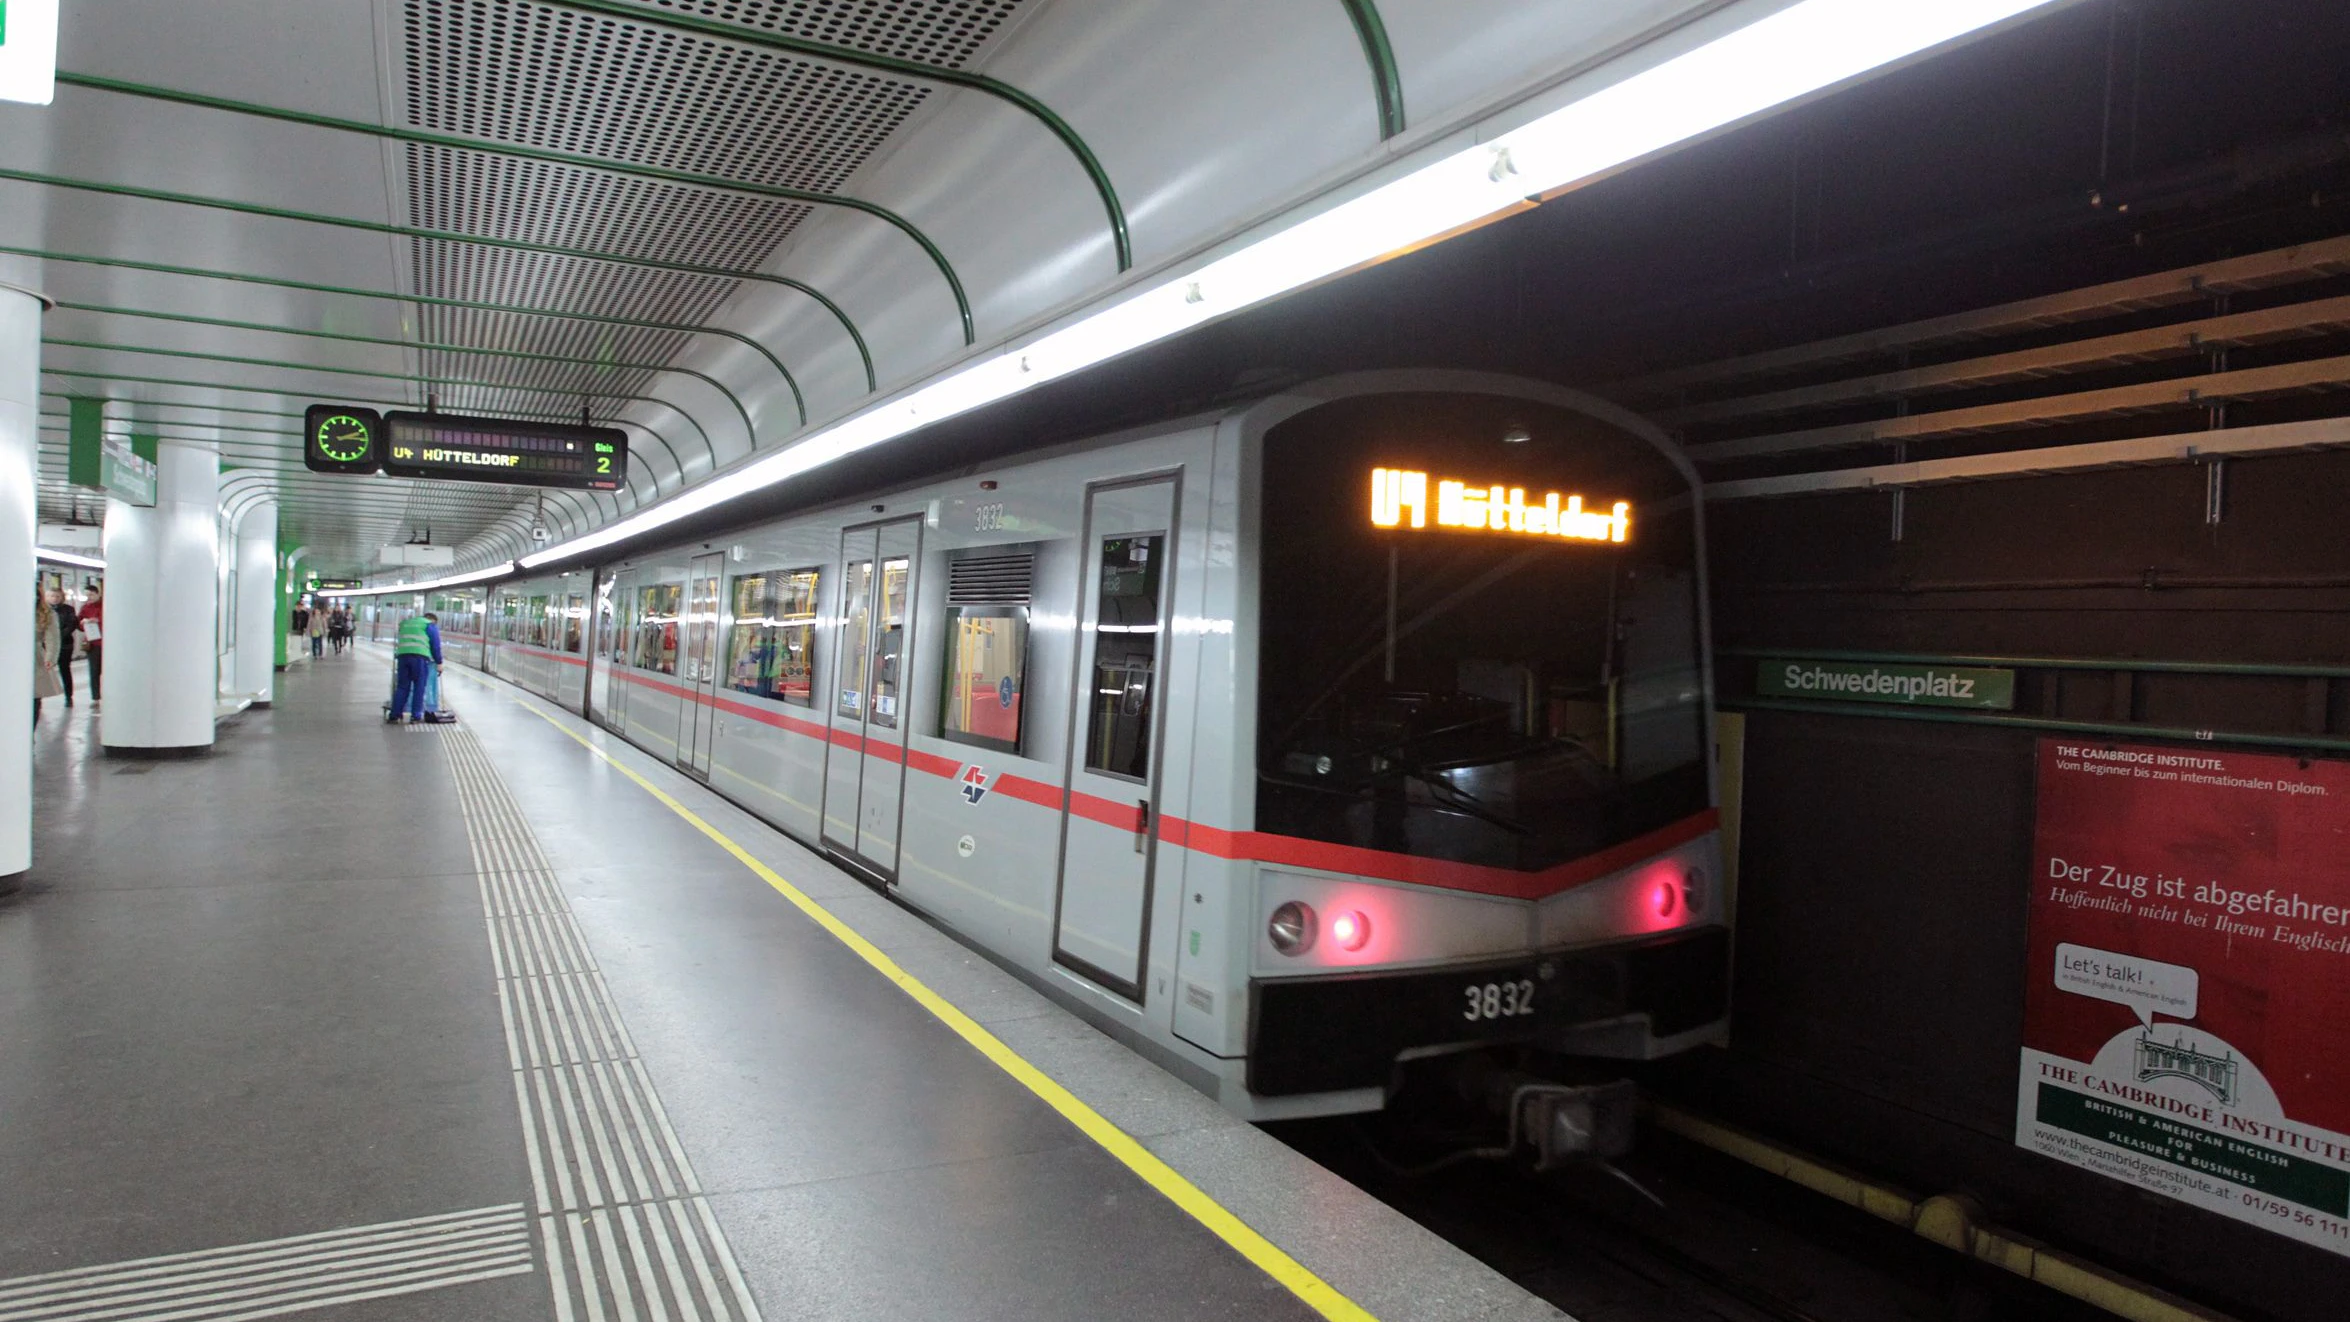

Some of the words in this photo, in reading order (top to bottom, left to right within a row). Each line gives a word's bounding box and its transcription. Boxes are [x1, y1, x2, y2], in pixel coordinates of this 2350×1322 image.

[394, 447, 413, 460] U4
[424, 449, 519, 466] HÜTTELDORF
[597, 457, 610, 473] 2
[1371, 468, 1427, 528] U4
[975, 504, 1003, 532] 3832
[1784, 664, 1976, 700] Schwedenplatz
[2056, 746, 2079, 758] THE
[2082, 748, 2154, 764] CAMBRIDGE
[2157, 755, 2225, 771] INSTITUTE.
[2056, 759, 2081, 771] Vom
[2083, 762, 2131, 777] Beginner
[2134, 766, 2150, 778] bis
[2152, 770, 2178, 781] zum
[2181, 772, 2273, 790] internationalen
[2277, 780, 2329, 796] Diplom.
[2050, 858, 2093, 883] Der
[2099, 865, 2149, 898] Zug
[2157, 874, 2186, 899] ist
[2050, 886, 2132, 914] Hoffentlich
[2138, 904, 2179, 923] nicht
[2184, 909, 2207, 928] bei
[2214, 915, 2265, 938] Ihrem
[2064, 955, 2100, 975] Let's
[2106, 963, 2142, 984] talk!
[1463, 979, 1535, 1022] 3832
[2038, 1061, 2078, 1085] THE
[2083, 1074, 2214, 1124] CAMBRIDGE
[2221, 1111, 2350, 1164] INSTITUTE
[2084, 1100, 2134, 1121] BRITISH
[2138, 1113, 2148, 1125] &
[2153, 1116, 2224, 1148] AMERICAN
[2228, 1141, 2289, 1168] ENGLISH
[2167, 1136, 2194, 1152] FOR
[2108, 1131, 2171, 1158] PLEASURE
[2176, 1151, 2186, 1162] &
[2191, 1156, 2257, 1184] BUSINESS
[2034, 1129, 2229, 1199] www.thecambridgeinstitute.at
[2242, 1193, 2290, 1218] 01/59
[2294, 1210, 2315, 1227] 56
[2319, 1219, 2349, 1239] 111
